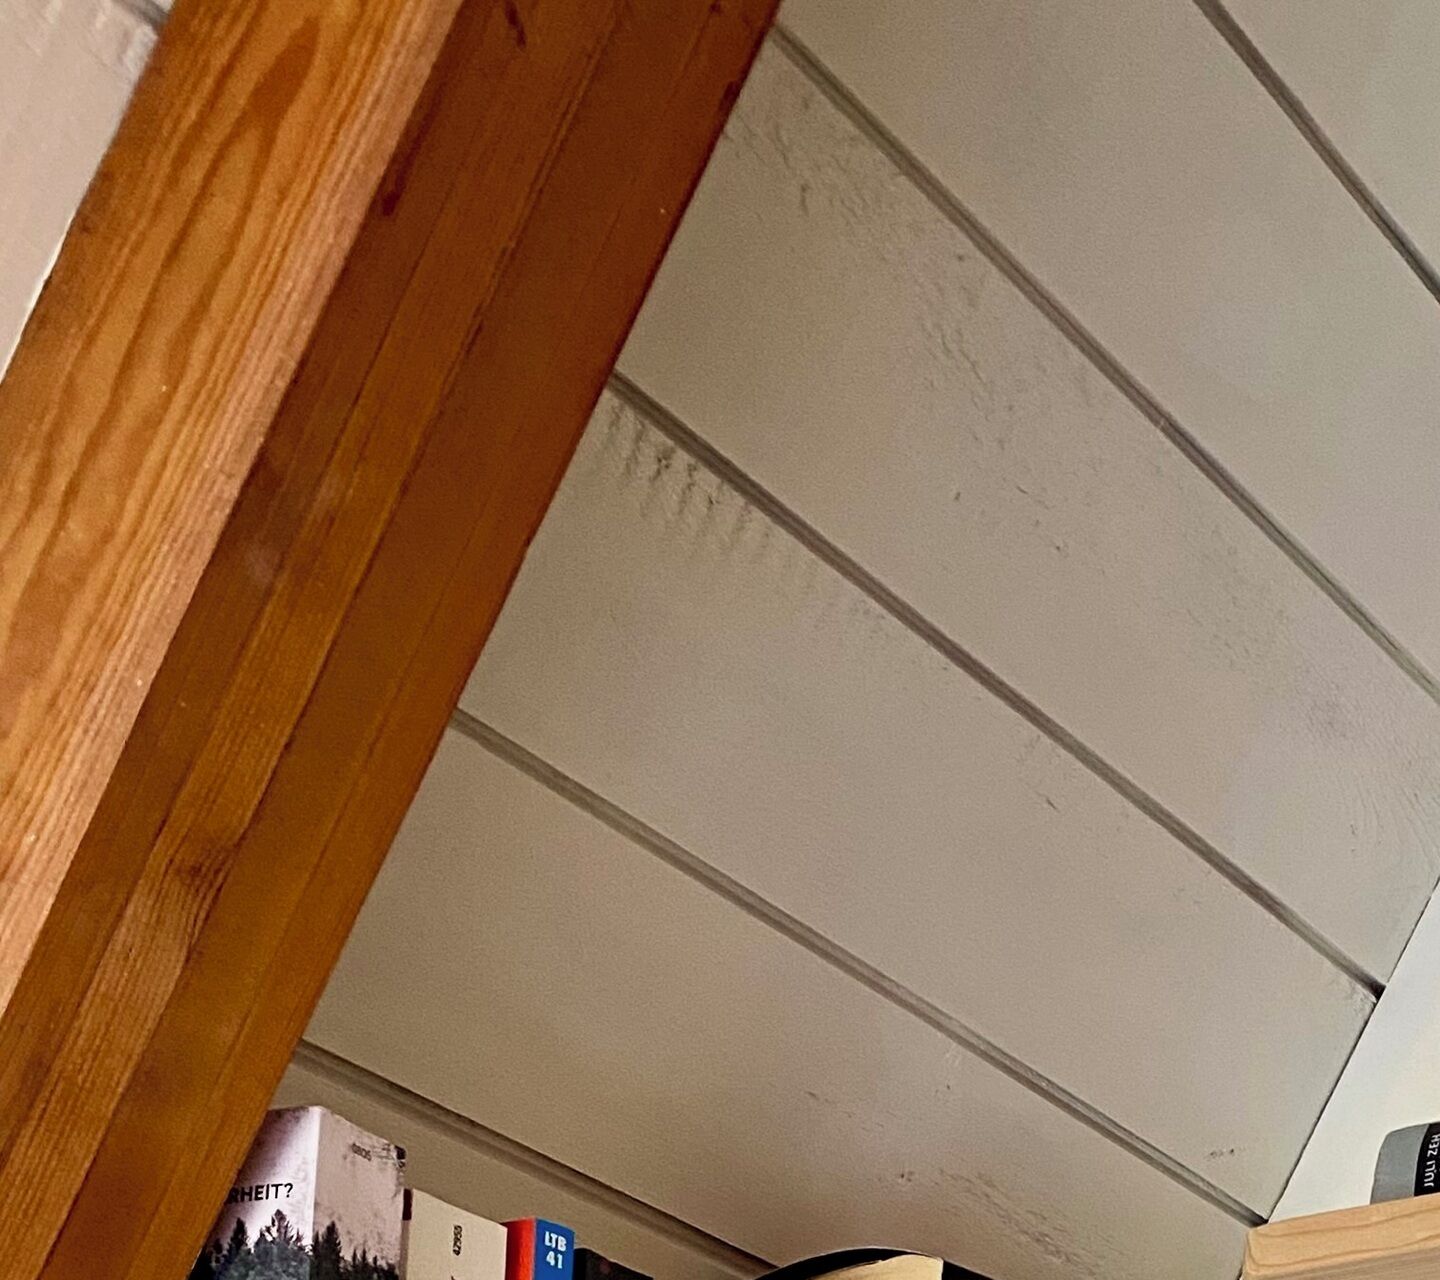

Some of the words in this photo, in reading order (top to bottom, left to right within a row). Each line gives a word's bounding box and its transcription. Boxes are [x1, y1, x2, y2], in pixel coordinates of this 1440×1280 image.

[1423, 1159, 1437, 1188] JULI
[543, 1229, 568, 1254] LTB
[545, 1249, 564, 1270] 41
